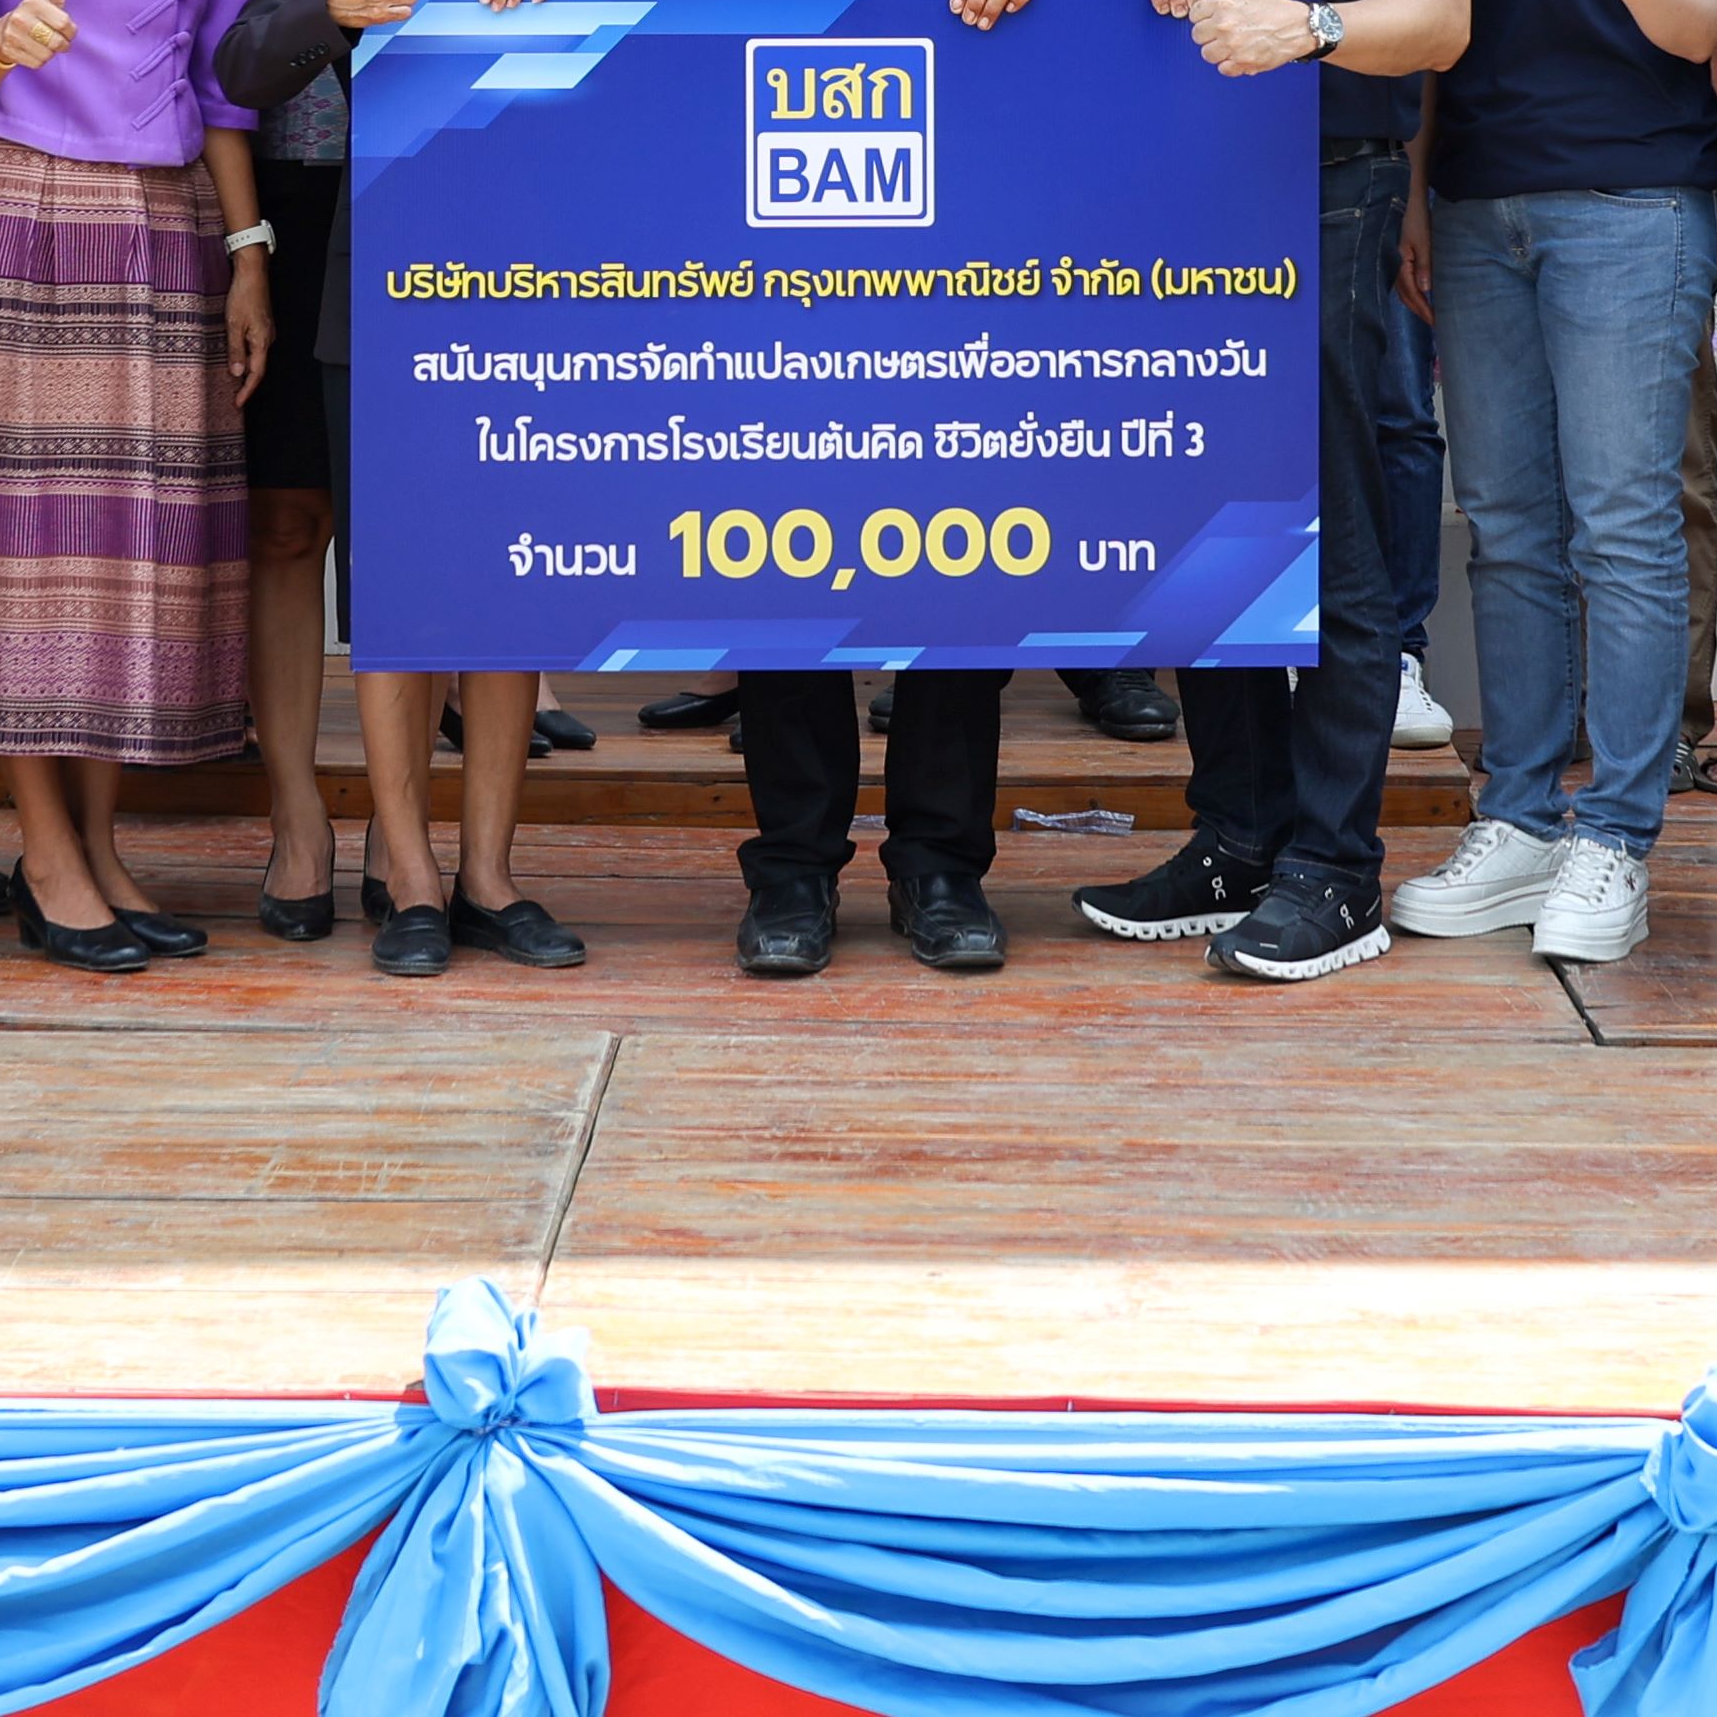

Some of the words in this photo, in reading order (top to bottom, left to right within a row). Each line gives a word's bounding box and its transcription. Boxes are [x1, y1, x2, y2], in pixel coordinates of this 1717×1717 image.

[767, 64, 913, 119] บสก
[769, 148, 912, 204] BAM
[386, 259, 754, 299] บริษัทบริหารสินทรัพย์
[763, 257, 1041, 309] กรุงเทพพาณิชย์
[1051, 256, 1141, 297] จำกัด
[1151, 258, 1297, 300] (มหาชน)
[412, 332, 1268, 391] สนับสนุนการจัดทำแปลงเกษตรเพื่ออาหารกลางวัน
[475, 414, 924, 463] ในโครงการโรงเรียนต้นคิด
[934, 412, 1111, 461] ชีวิตยั่งยืน
[1121, 410, 1175, 458] ปีที่
[1185, 422, 1205, 458] 3
[507, 532, 637, 577] จำนวน
[669, 506, 1052, 591] 100,000
[1078, 539, 1156, 573] บาท
